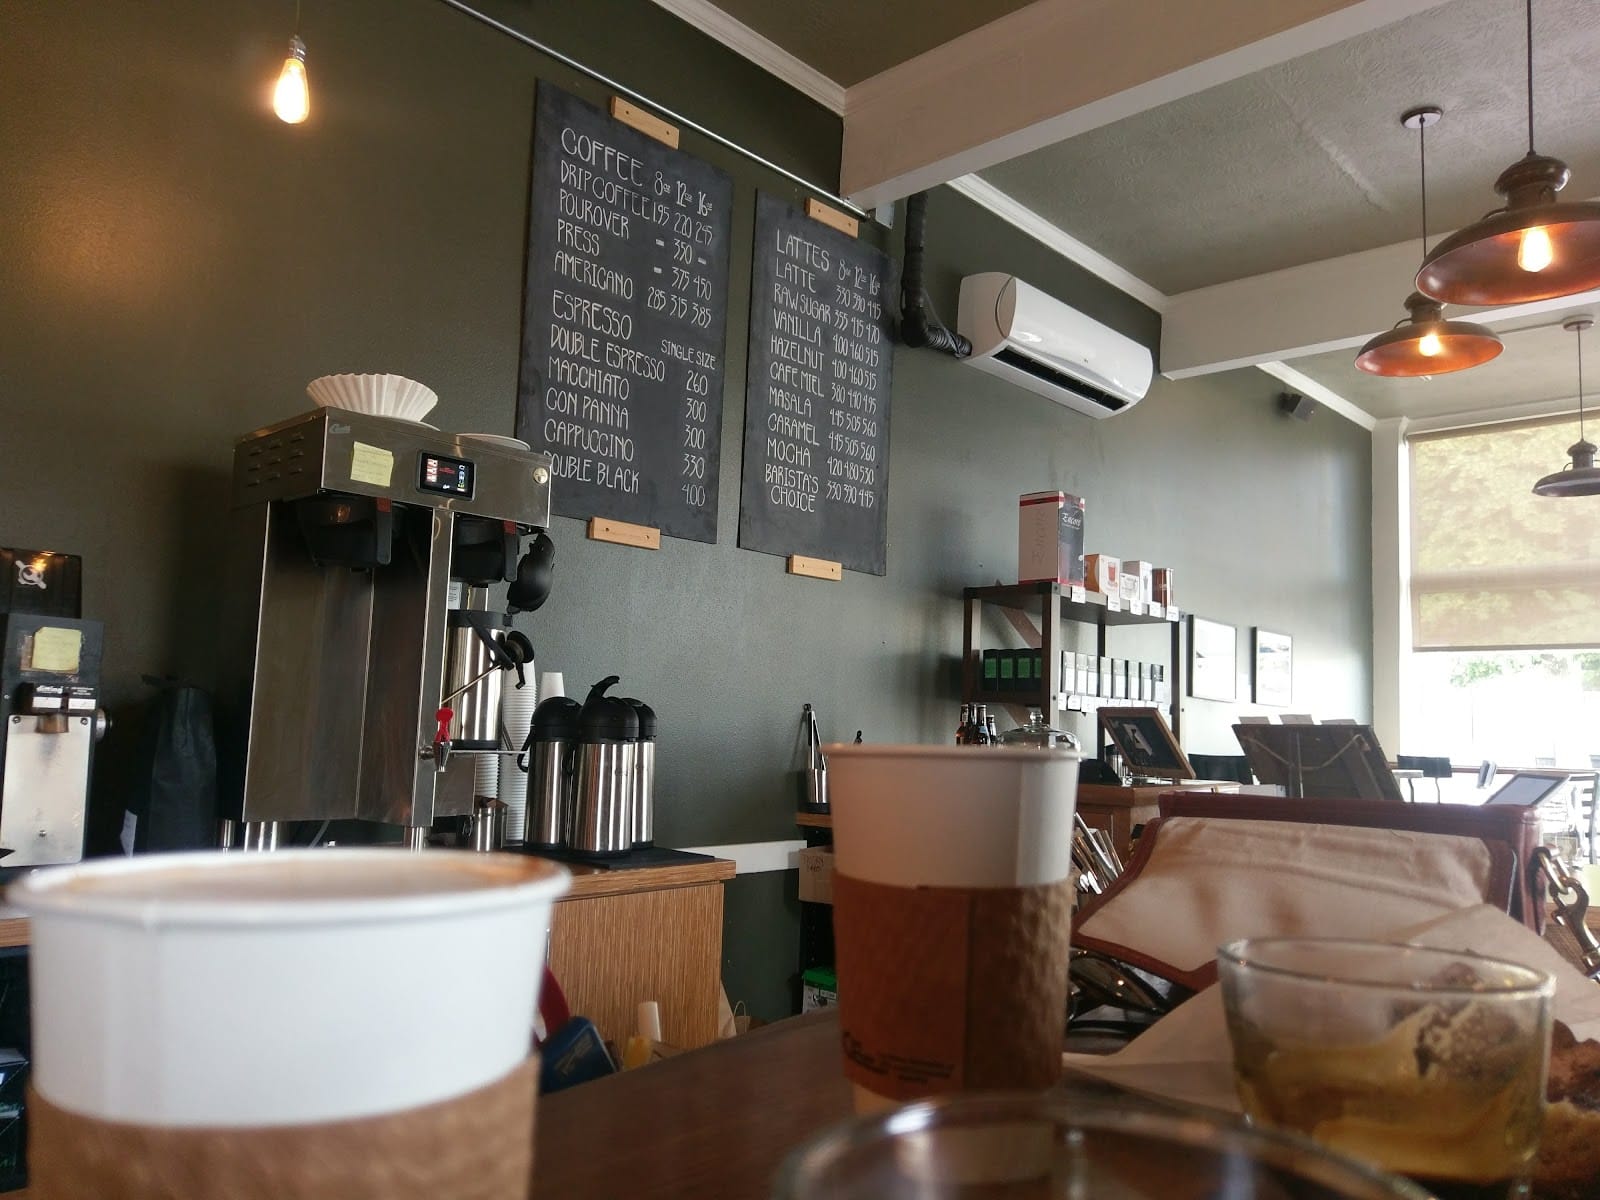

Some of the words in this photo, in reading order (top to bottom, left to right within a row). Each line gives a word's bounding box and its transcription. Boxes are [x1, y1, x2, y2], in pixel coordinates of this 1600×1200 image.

[561, 127, 644, 187] COFFEE
[560, 160, 592, 192] DRIP
[592, 176, 651, 223] COFFEE
[559, 188, 630, 240] POUROVER
[557, 218, 600, 257] PRESS
[776, 229, 830, 272] LATTES
[554, 250, 633, 300] AMERICANO
[775, 257, 817, 294] LATTE
[553, 290, 633, 341] ESPRESSO
[774, 283, 799, 311] RAW
[799, 294, 831, 325] SUGAR
[773, 308, 821, 347] VANILLA
[551, 324, 599, 364] DOUBLE
[606, 343, 665, 382] ESPRESSO
[660, 339, 694, 364] SINGLE
[696, 349, 716, 371] SIZE
[770, 334, 825, 372] HAZELNUT
[548, 356, 630, 401] MACCHIATO
[769, 362, 799, 387] CAFE
[800, 370, 825, 398] MIEL
[546, 387, 578, 417] CON
[582, 395, 629, 431] PANNA
[769, 386, 812, 418] MASALA
[544, 418, 634, 462] CAPPUCCINO
[767, 413, 820, 446] CARAMEL
[766, 437, 811, 468] MOCHA
[597, 462, 640, 494] BLACK
[765, 463, 819, 494] BARISTA'S
[771, 485, 816, 513] CHOICE
